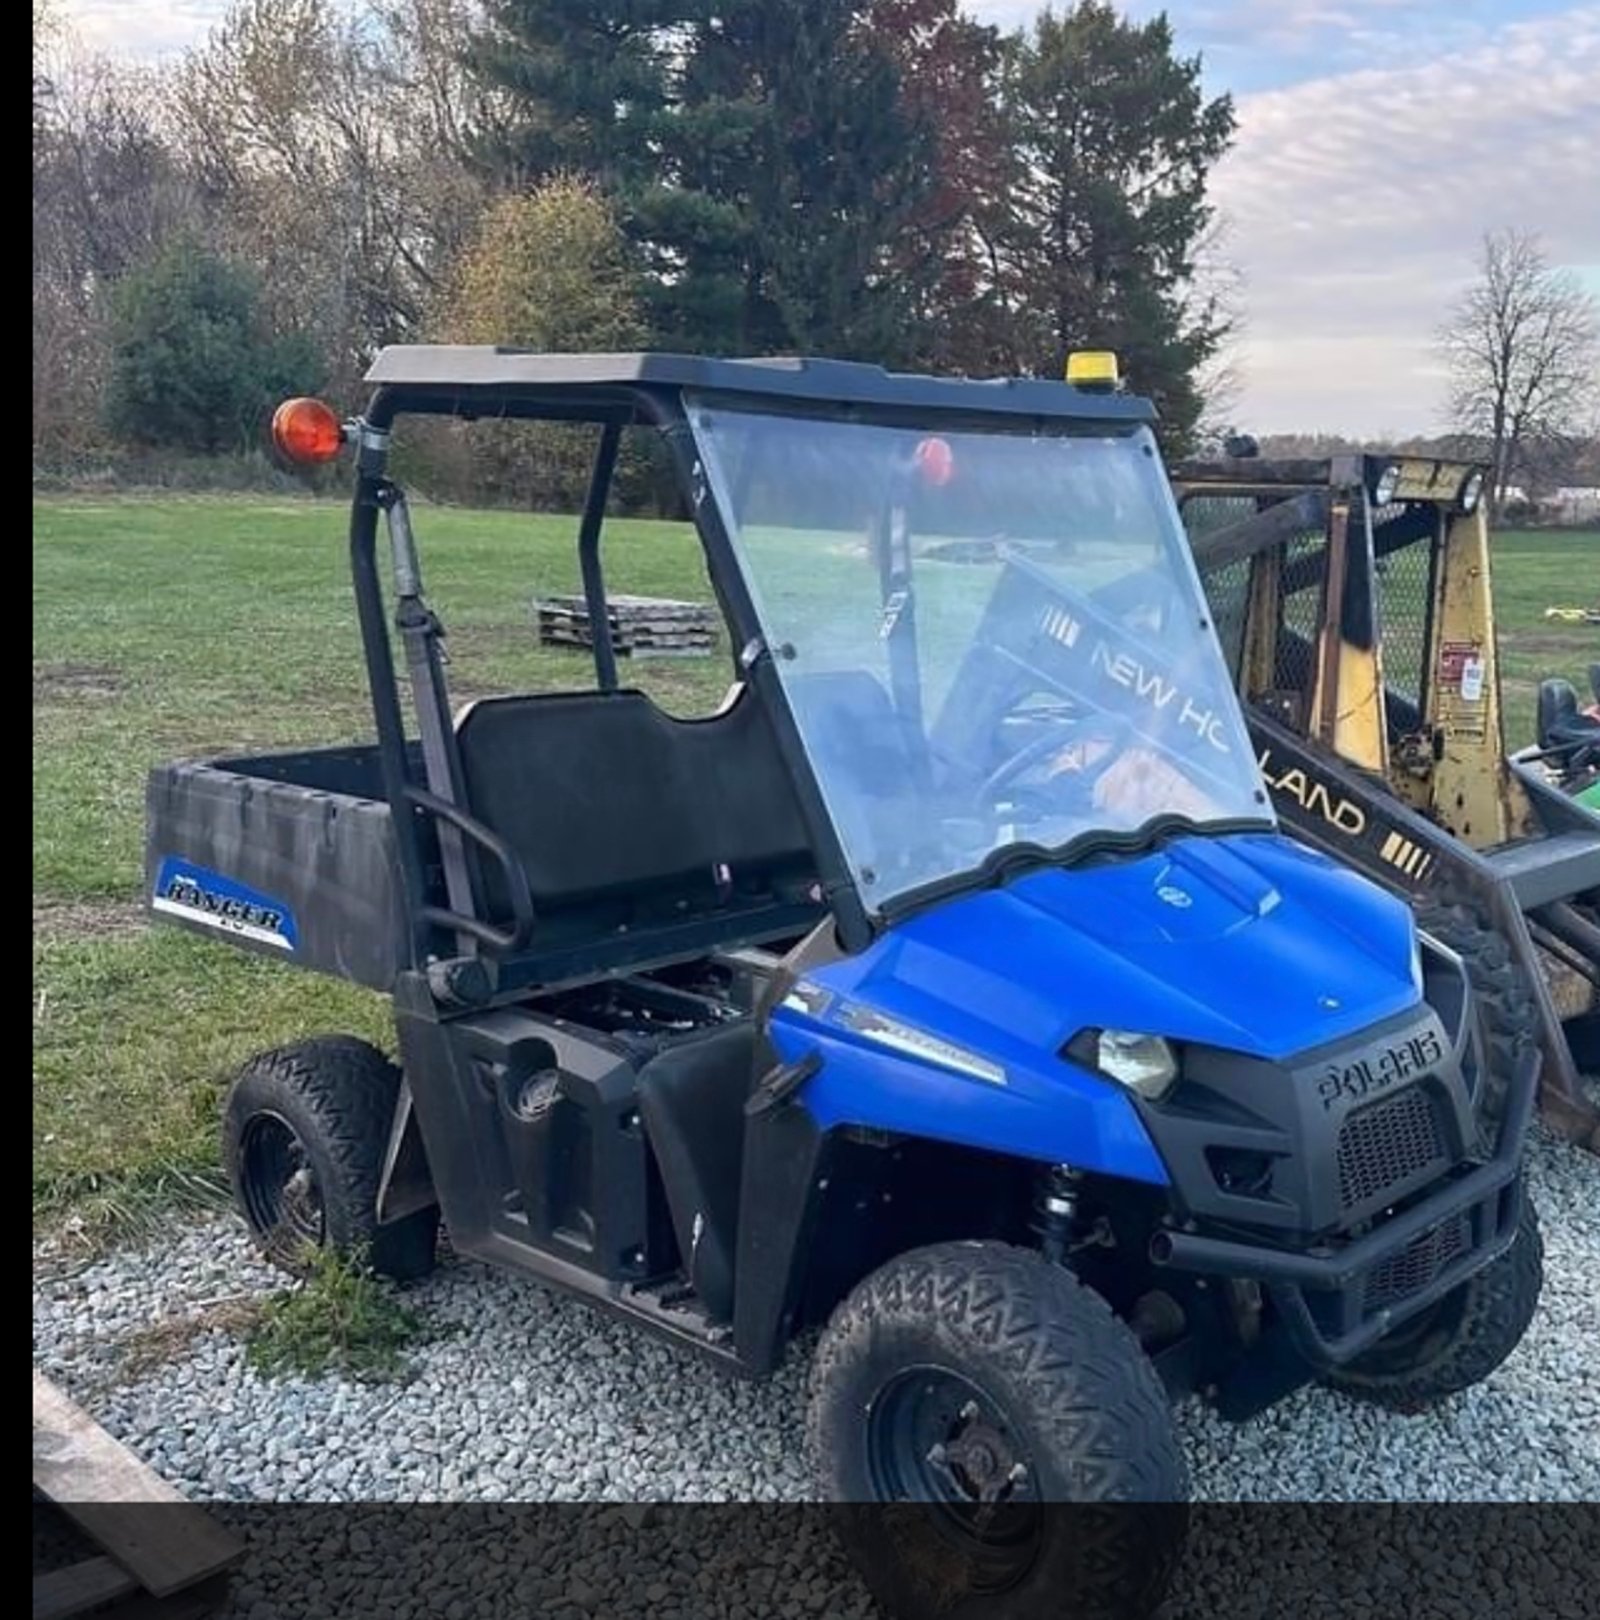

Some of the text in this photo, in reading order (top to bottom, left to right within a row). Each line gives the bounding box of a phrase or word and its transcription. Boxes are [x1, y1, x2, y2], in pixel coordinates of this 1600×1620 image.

[1092, 641, 1177, 708] NEW
[167, 882, 282, 930] RANGER
[1317, 1030, 1441, 1112] POLARIS
